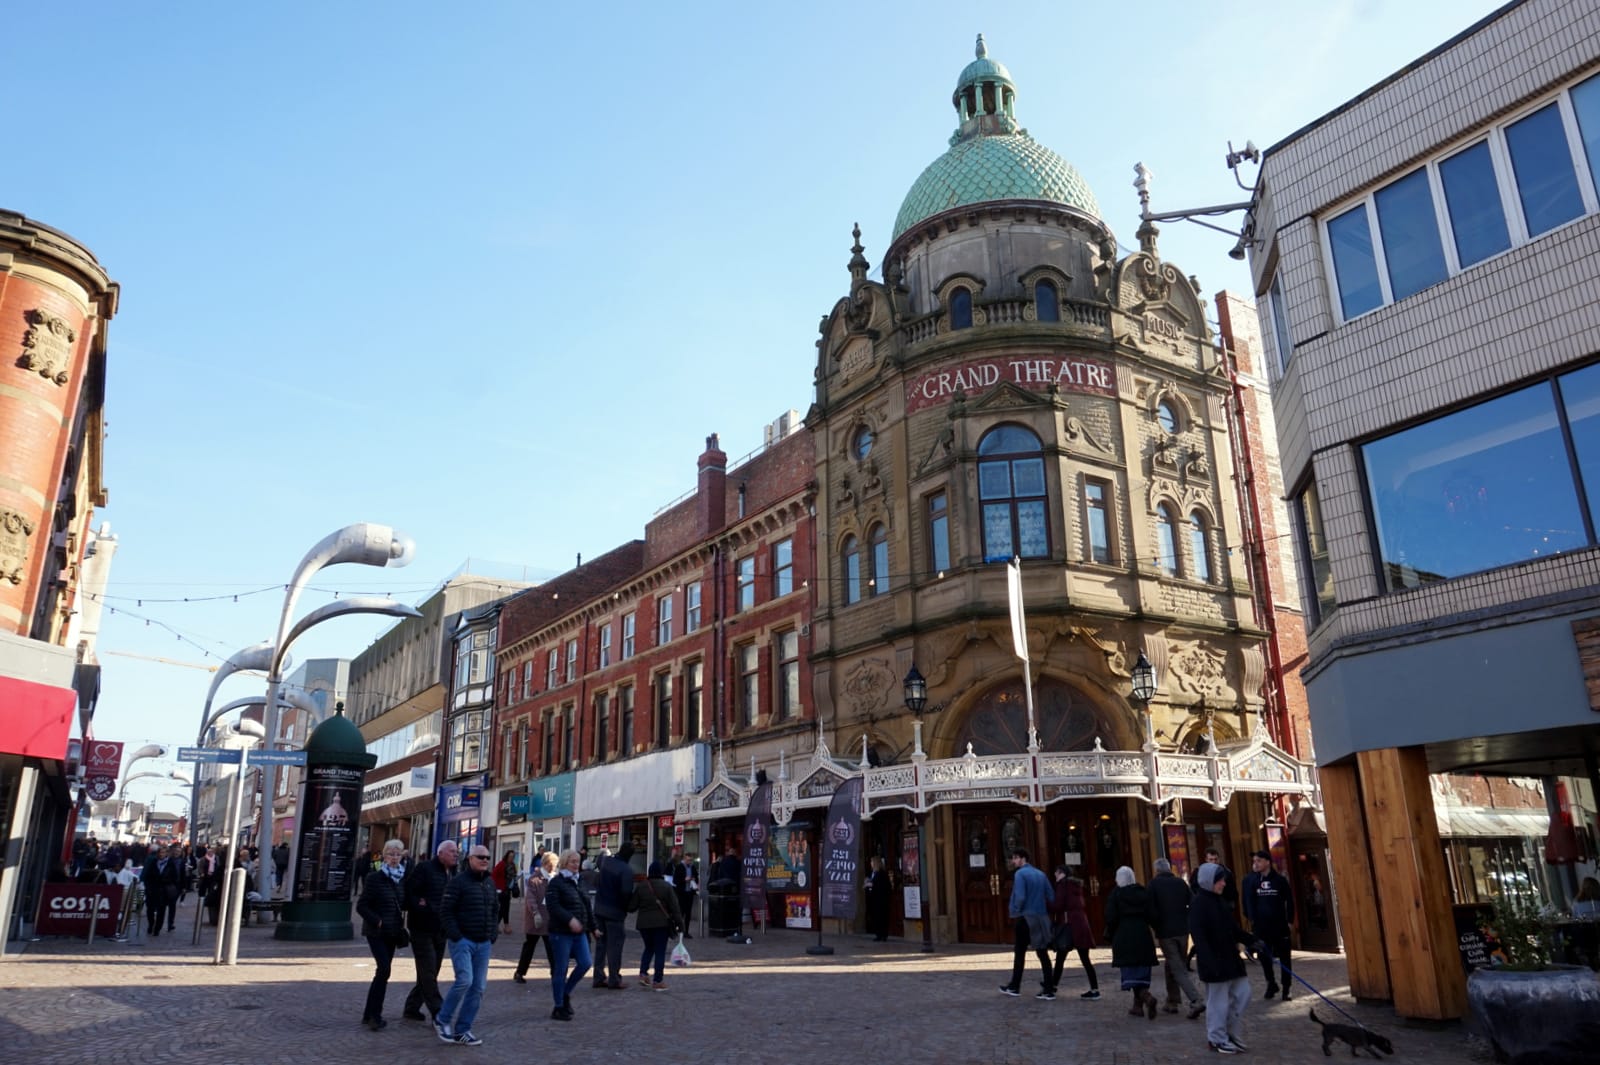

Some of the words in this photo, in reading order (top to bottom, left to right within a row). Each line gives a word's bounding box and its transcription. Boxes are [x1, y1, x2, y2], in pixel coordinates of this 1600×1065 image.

[1147, 316, 1184, 340] MUSIC
[910, 382, 922, 399] THE
[922, 363, 1000, 399] GRAND
[1009, 360, 1112, 389] THEATRE
[544, 786, 558, 803] VIP
[935, 790, 965, 800] GRAND
[972, 788, 1015, 798] THEATRE
[1058, 784, 1094, 794] GRAND
[513, 800, 528, 808] VIP
[749, 848, 762, 856] 125
[743, 858, 766, 866] OPEN
[746, 868, 763, 876] DAY
[50, 896, 110, 911] COSTA
